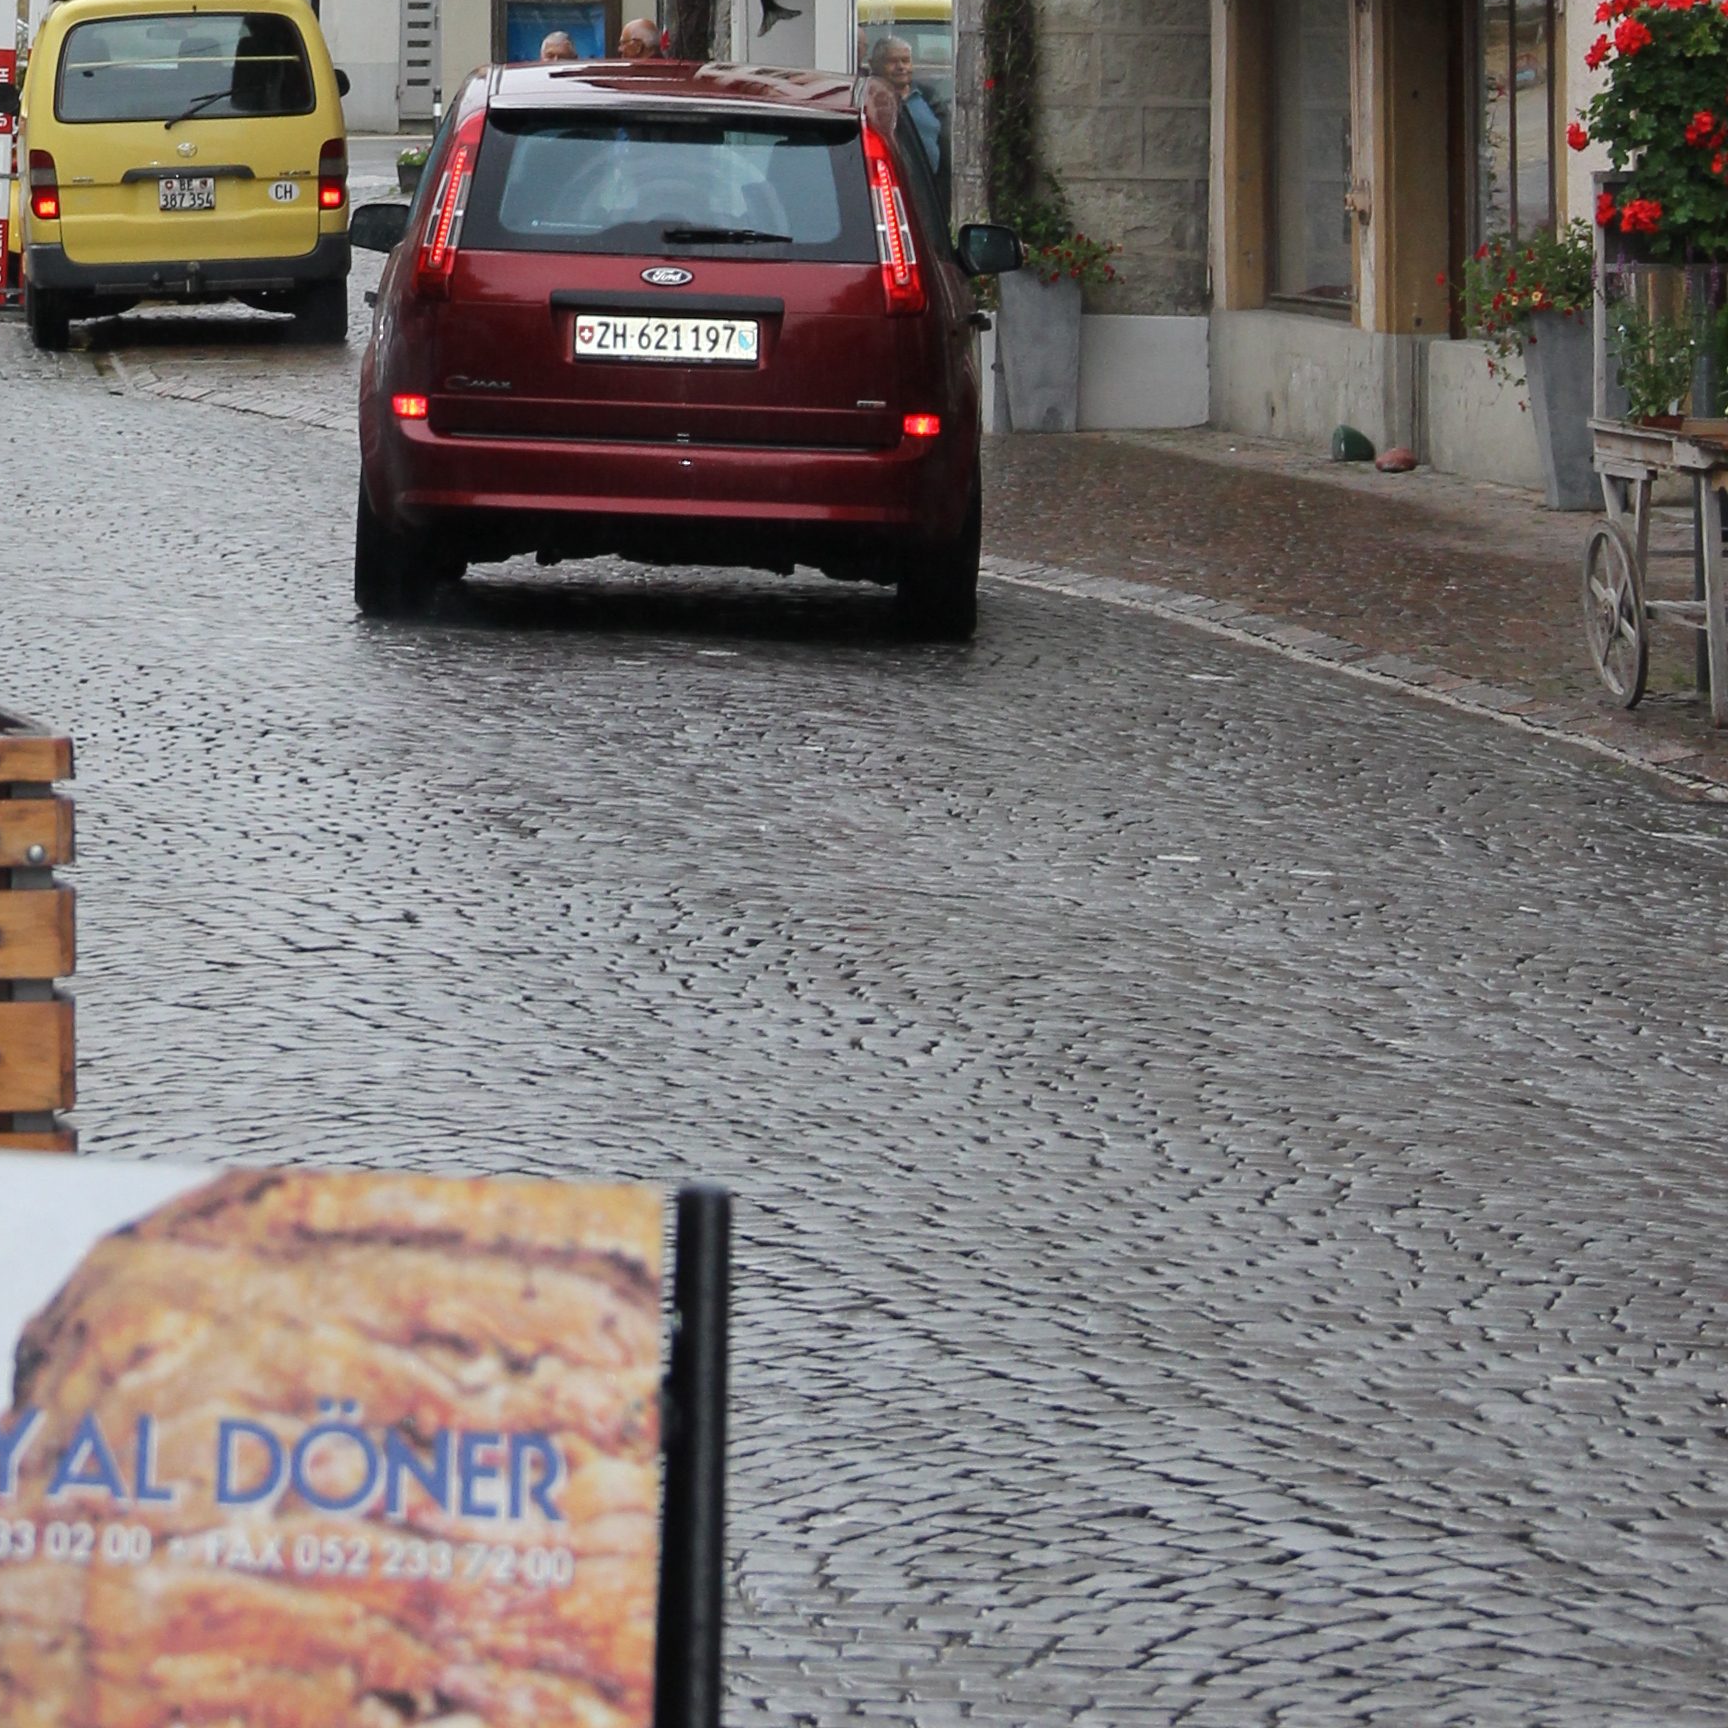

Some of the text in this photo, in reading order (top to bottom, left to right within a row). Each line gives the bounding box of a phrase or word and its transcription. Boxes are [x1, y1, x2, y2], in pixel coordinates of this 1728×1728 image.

[275, 183, 293, 200] CH
[216, 1397, 565, 1521] DÖNER
[43, 1519, 95, 1564] 02
[101, 1523, 153, 1567] 00
[294, 1535, 370, 1578] 052
[380, 1540, 454, 1581] 233
[520, 1546, 575, 1589] 00
